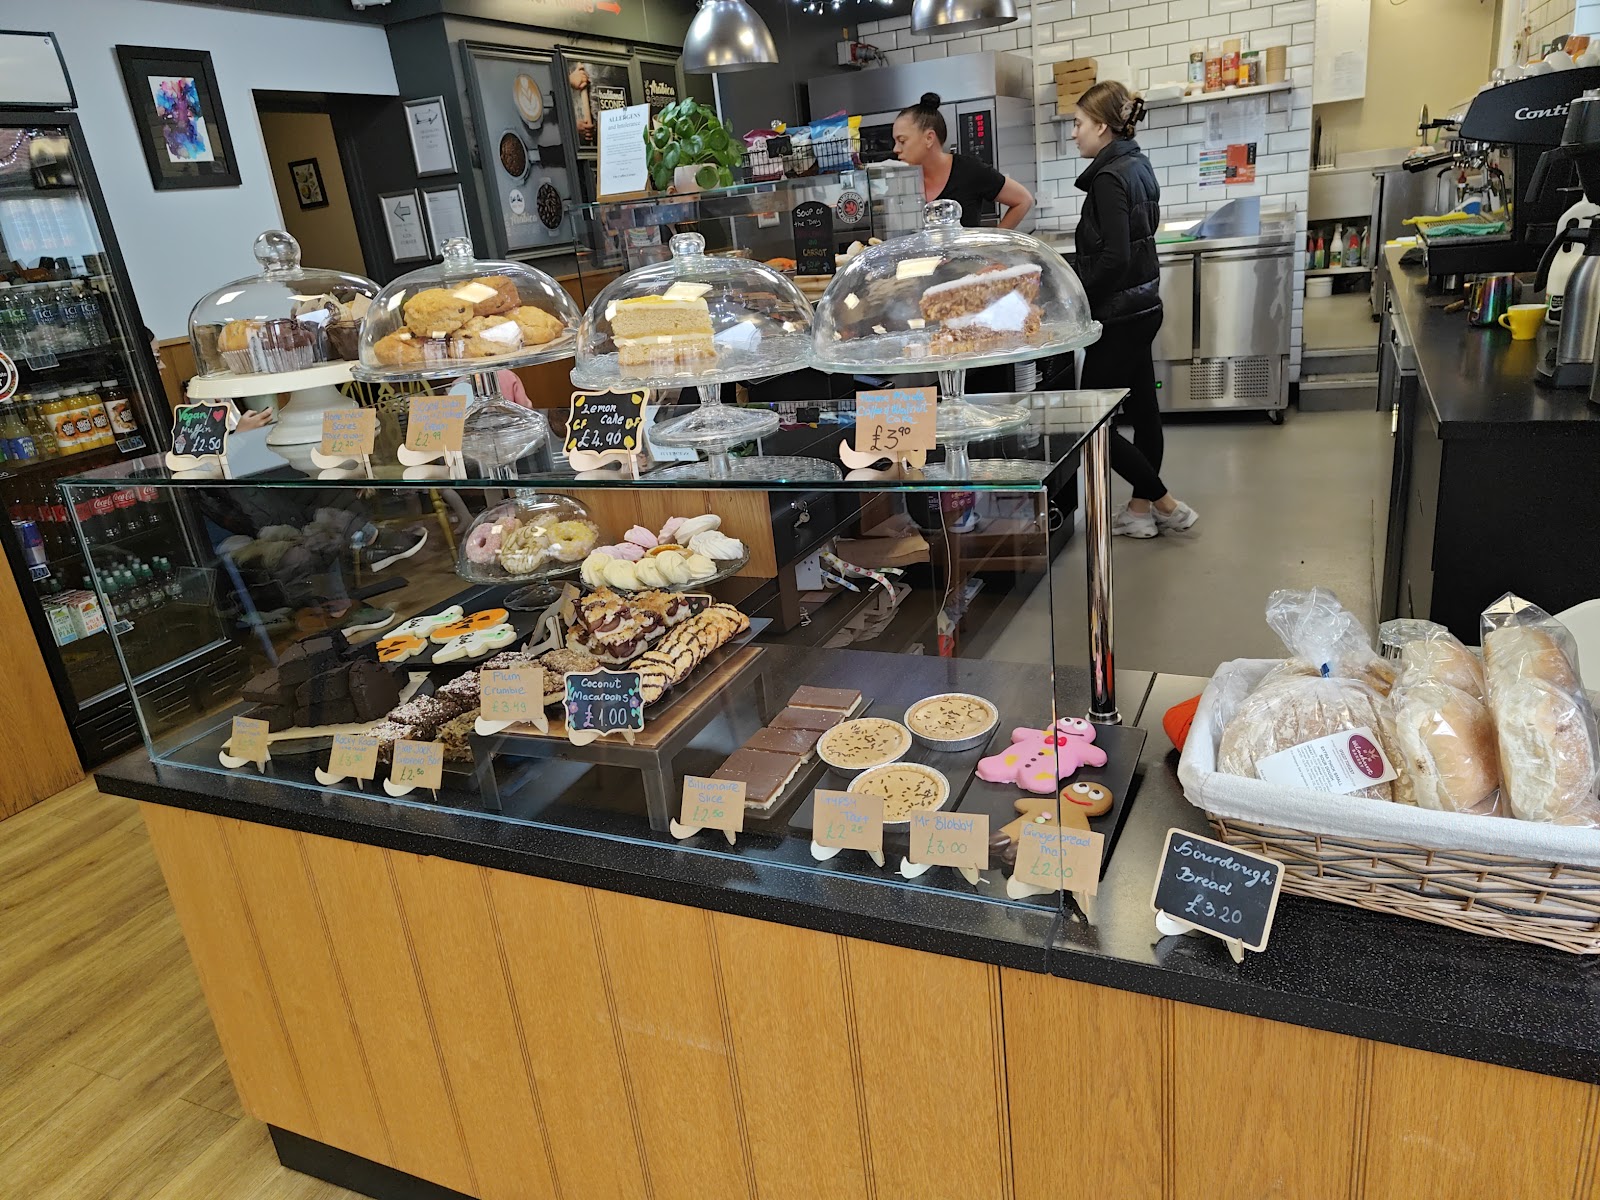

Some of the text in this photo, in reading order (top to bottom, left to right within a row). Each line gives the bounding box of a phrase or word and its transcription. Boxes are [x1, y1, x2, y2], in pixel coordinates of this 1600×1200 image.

[600, 99, 625, 109] SCONES
[608, 113, 641, 122] ALLERGENS
[1514, 103, 1570, 120] Conti
[8, 308, 26, 318] ICE
[81, 304, 96, 312] ICE
[581, 404, 617, 414] Lemon
[178, 406, 207, 426] Vegan
[191, 435, 221, 452] £2.50
[493, 672, 521, 683] Plum
[581, 678, 621, 688] Coconut
[573, 691, 629, 703] Macaroons
[492, 701, 527, 712] £3.49
[583, 704, 627, 728] £1.00
[335, 733, 356, 746] Rocky
[1320, 746, 1330, 760] EXTRA
[688, 778, 740, 792] Billionaire
[698, 793, 725, 804] Slice
[914, 815, 974, 832] Mr Blobby
[926, 833, 968, 854] £3.00
[1173, 840, 1274, 888] Sourdough
[1176, 866, 1233, 896] Bread
[1185, 894, 1243, 924] £3.20
